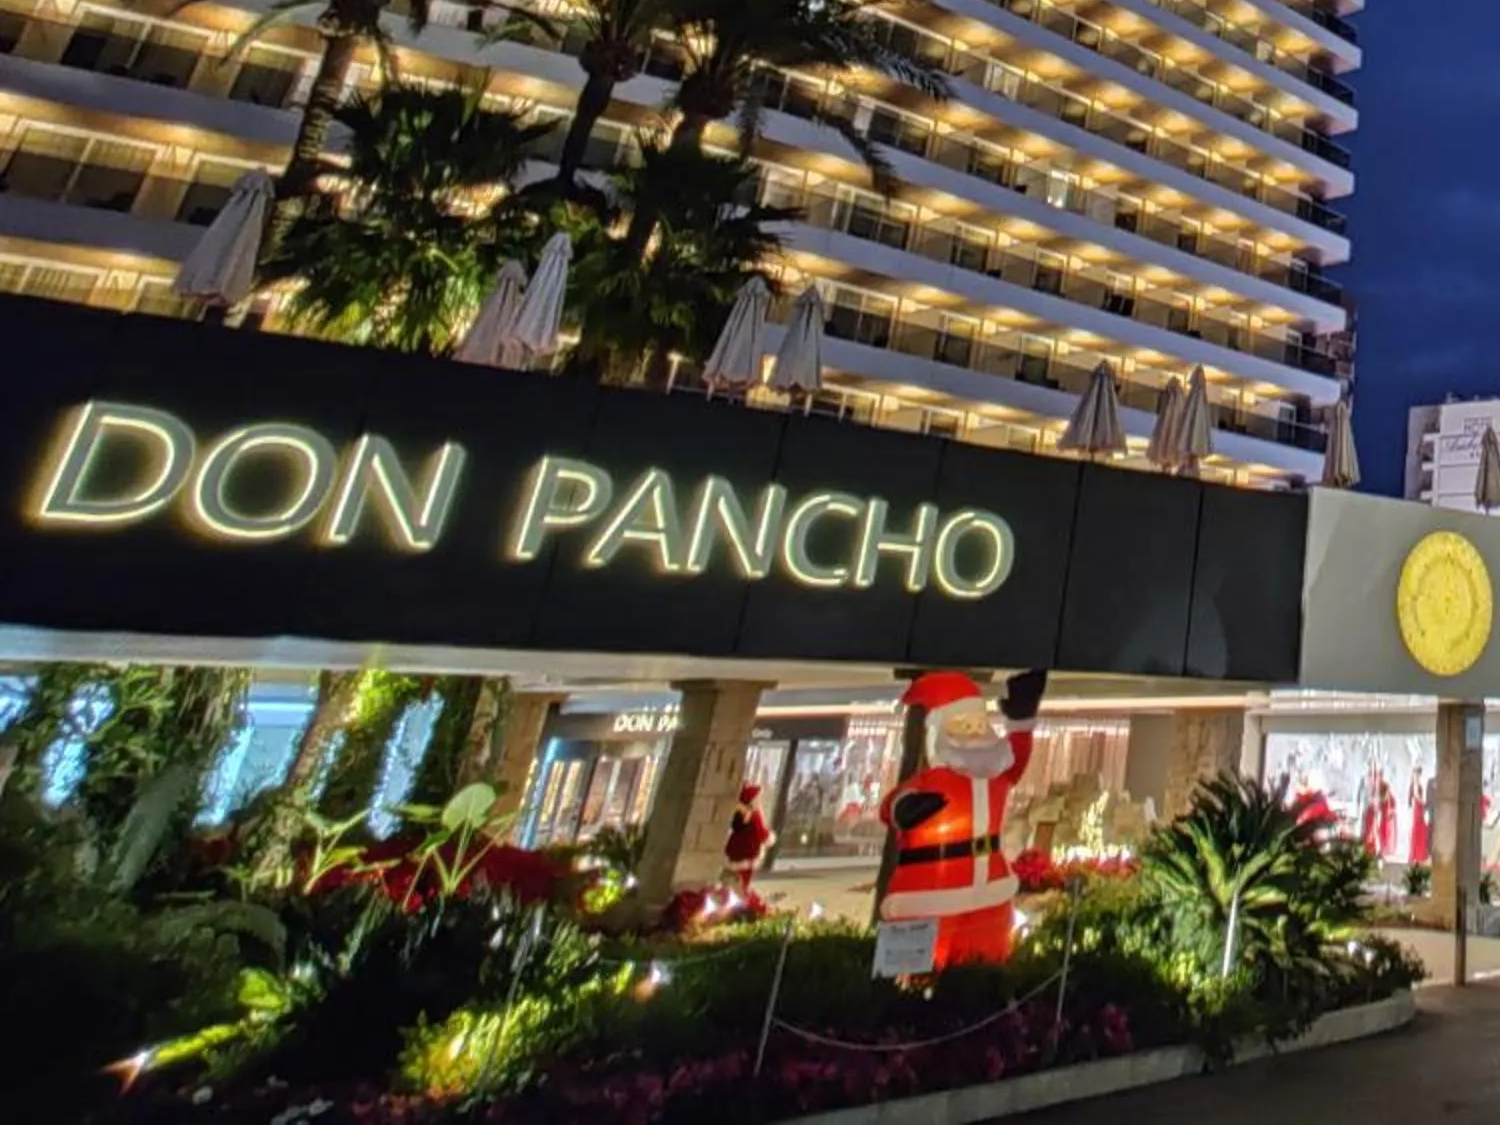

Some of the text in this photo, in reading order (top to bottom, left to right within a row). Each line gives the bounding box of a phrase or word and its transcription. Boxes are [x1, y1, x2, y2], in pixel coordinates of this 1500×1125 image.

[40, 400, 1015, 598] DON PANCHO
[613, 713, 654, 732] DON
